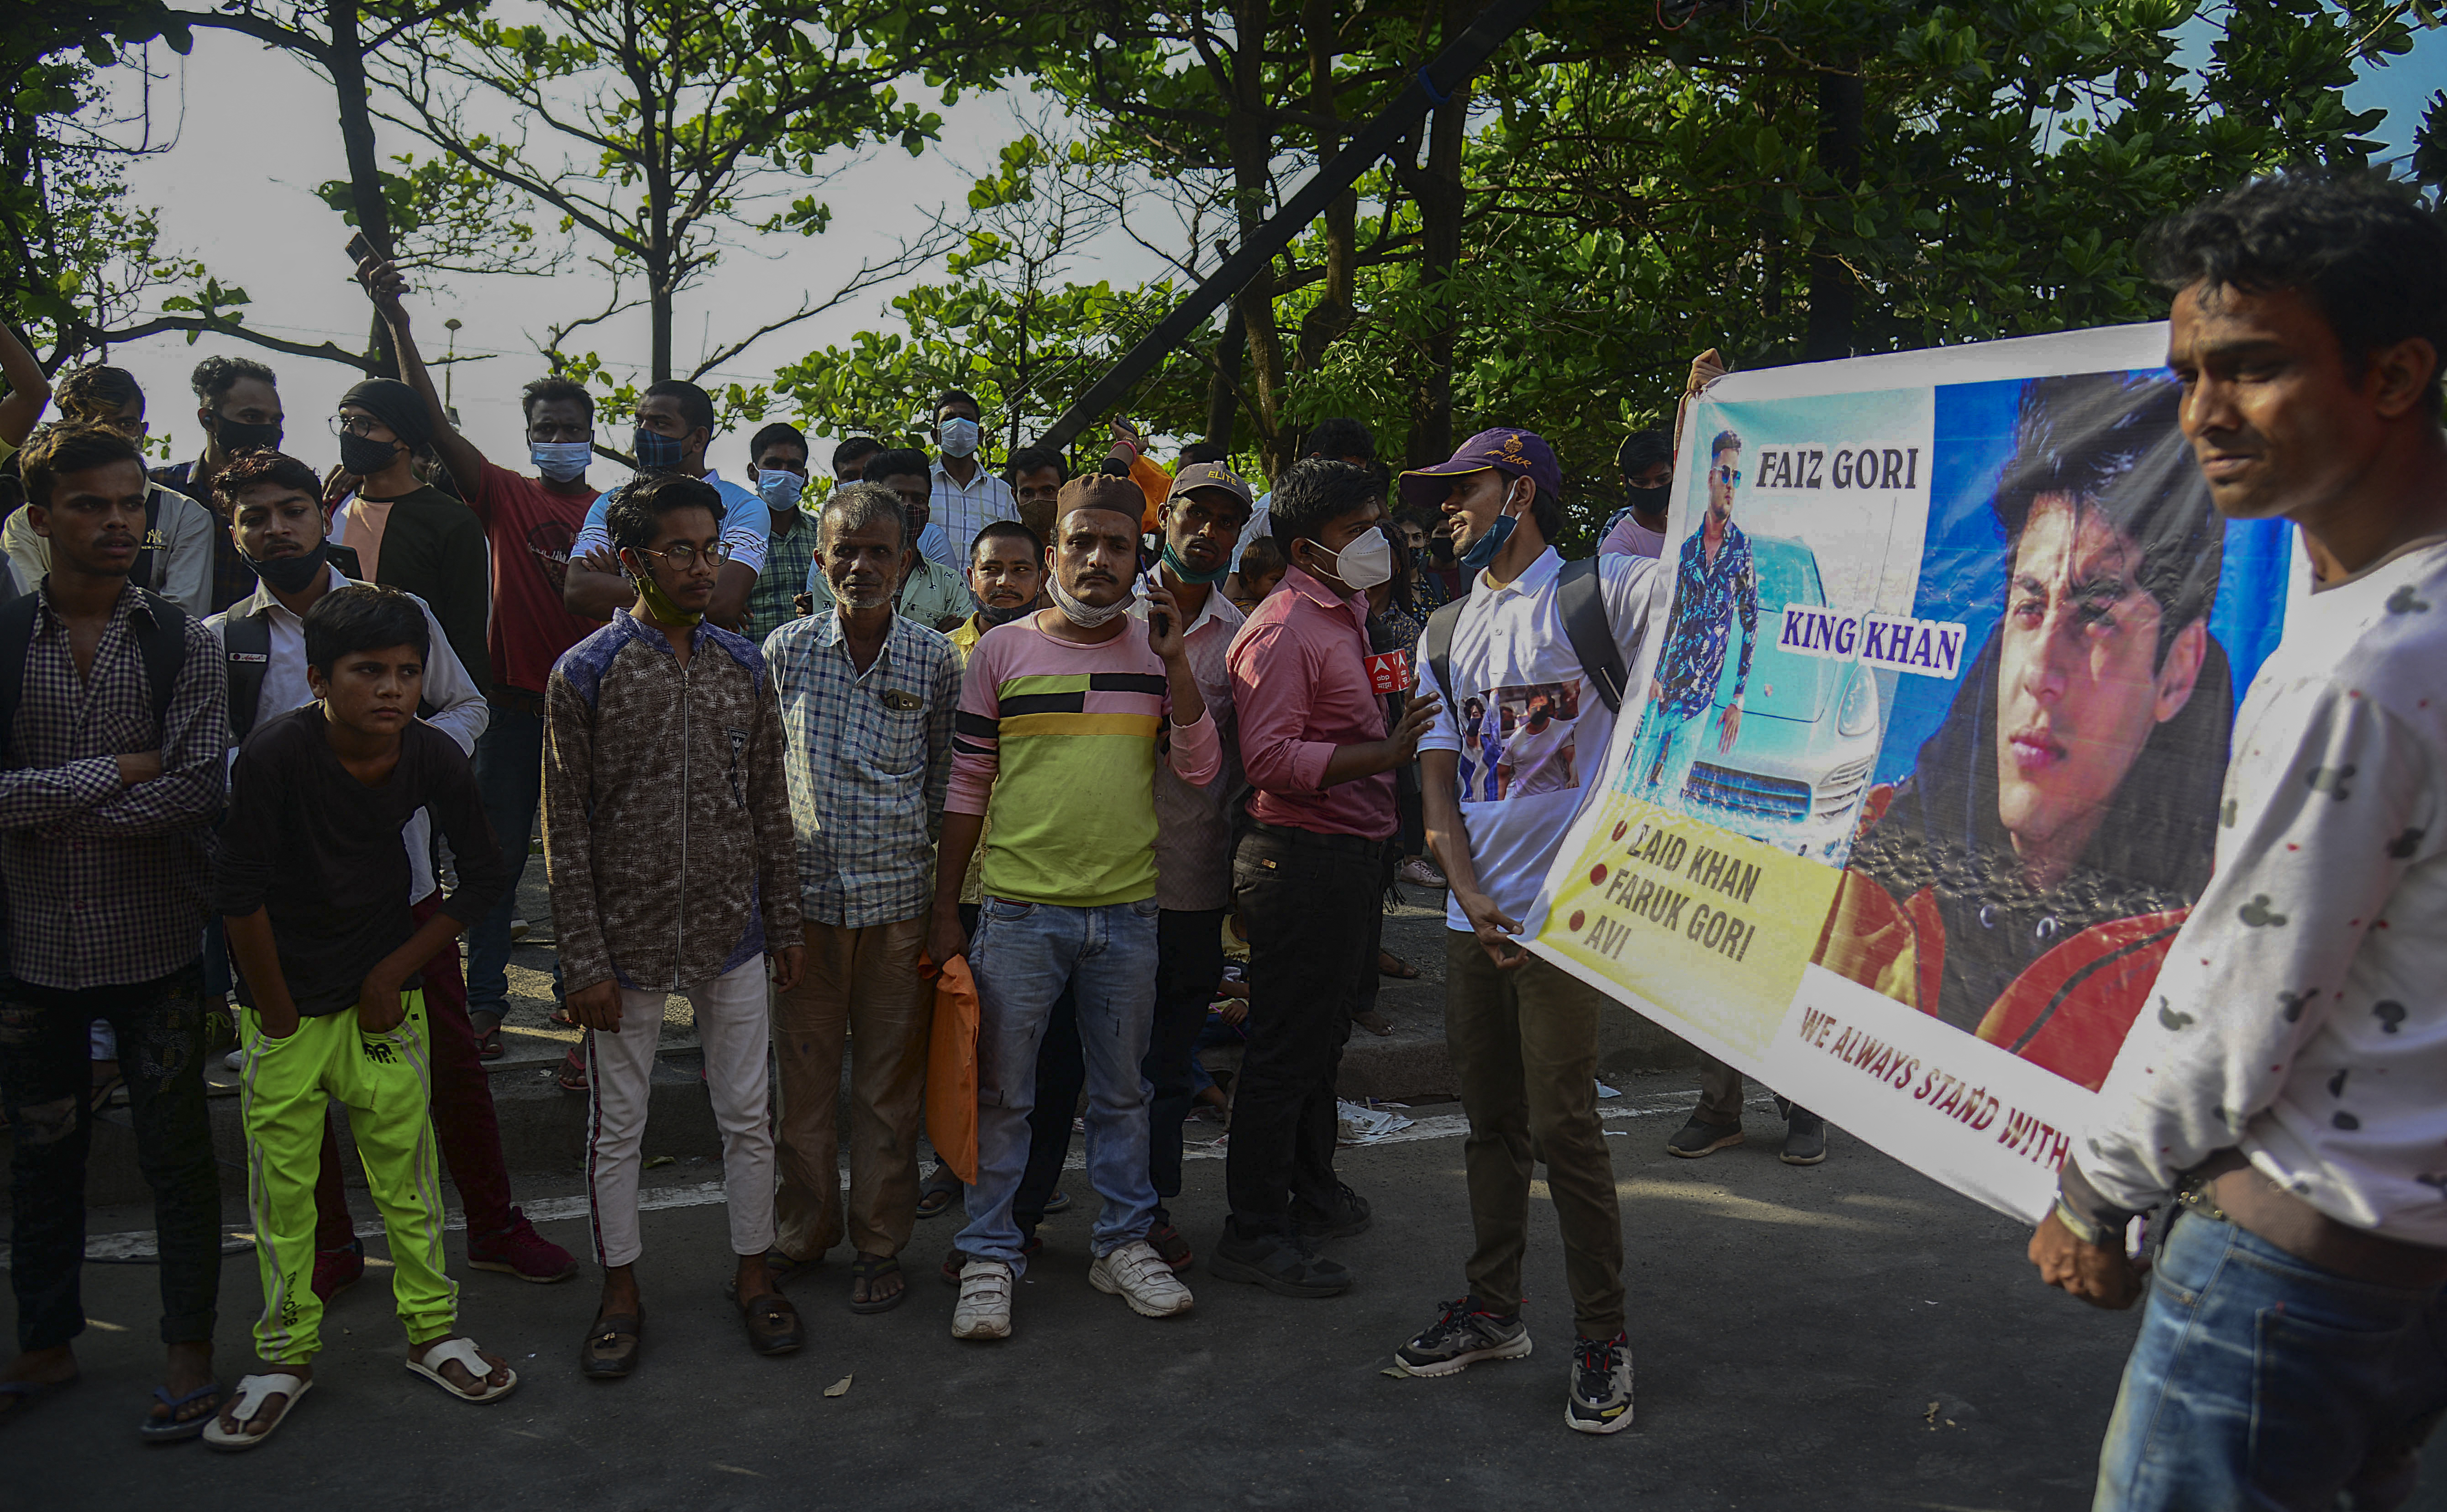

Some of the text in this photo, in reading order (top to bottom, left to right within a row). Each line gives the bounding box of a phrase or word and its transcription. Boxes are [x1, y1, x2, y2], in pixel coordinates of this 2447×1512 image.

[1208, 471, 1238, 486] ELITE
[1756, 448, 1919, 489] FAIZ GORI
[1781, 610, 1960, 671] KING KHAN
[1627, 824, 1762, 904] ZAID KHAN
[1583, 914, 1632, 960] AVI
[1604, 867, 1756, 962] FARUK GORI
[1800, 1006, 2070, 1175] WE ALWAYS STAND WITH
